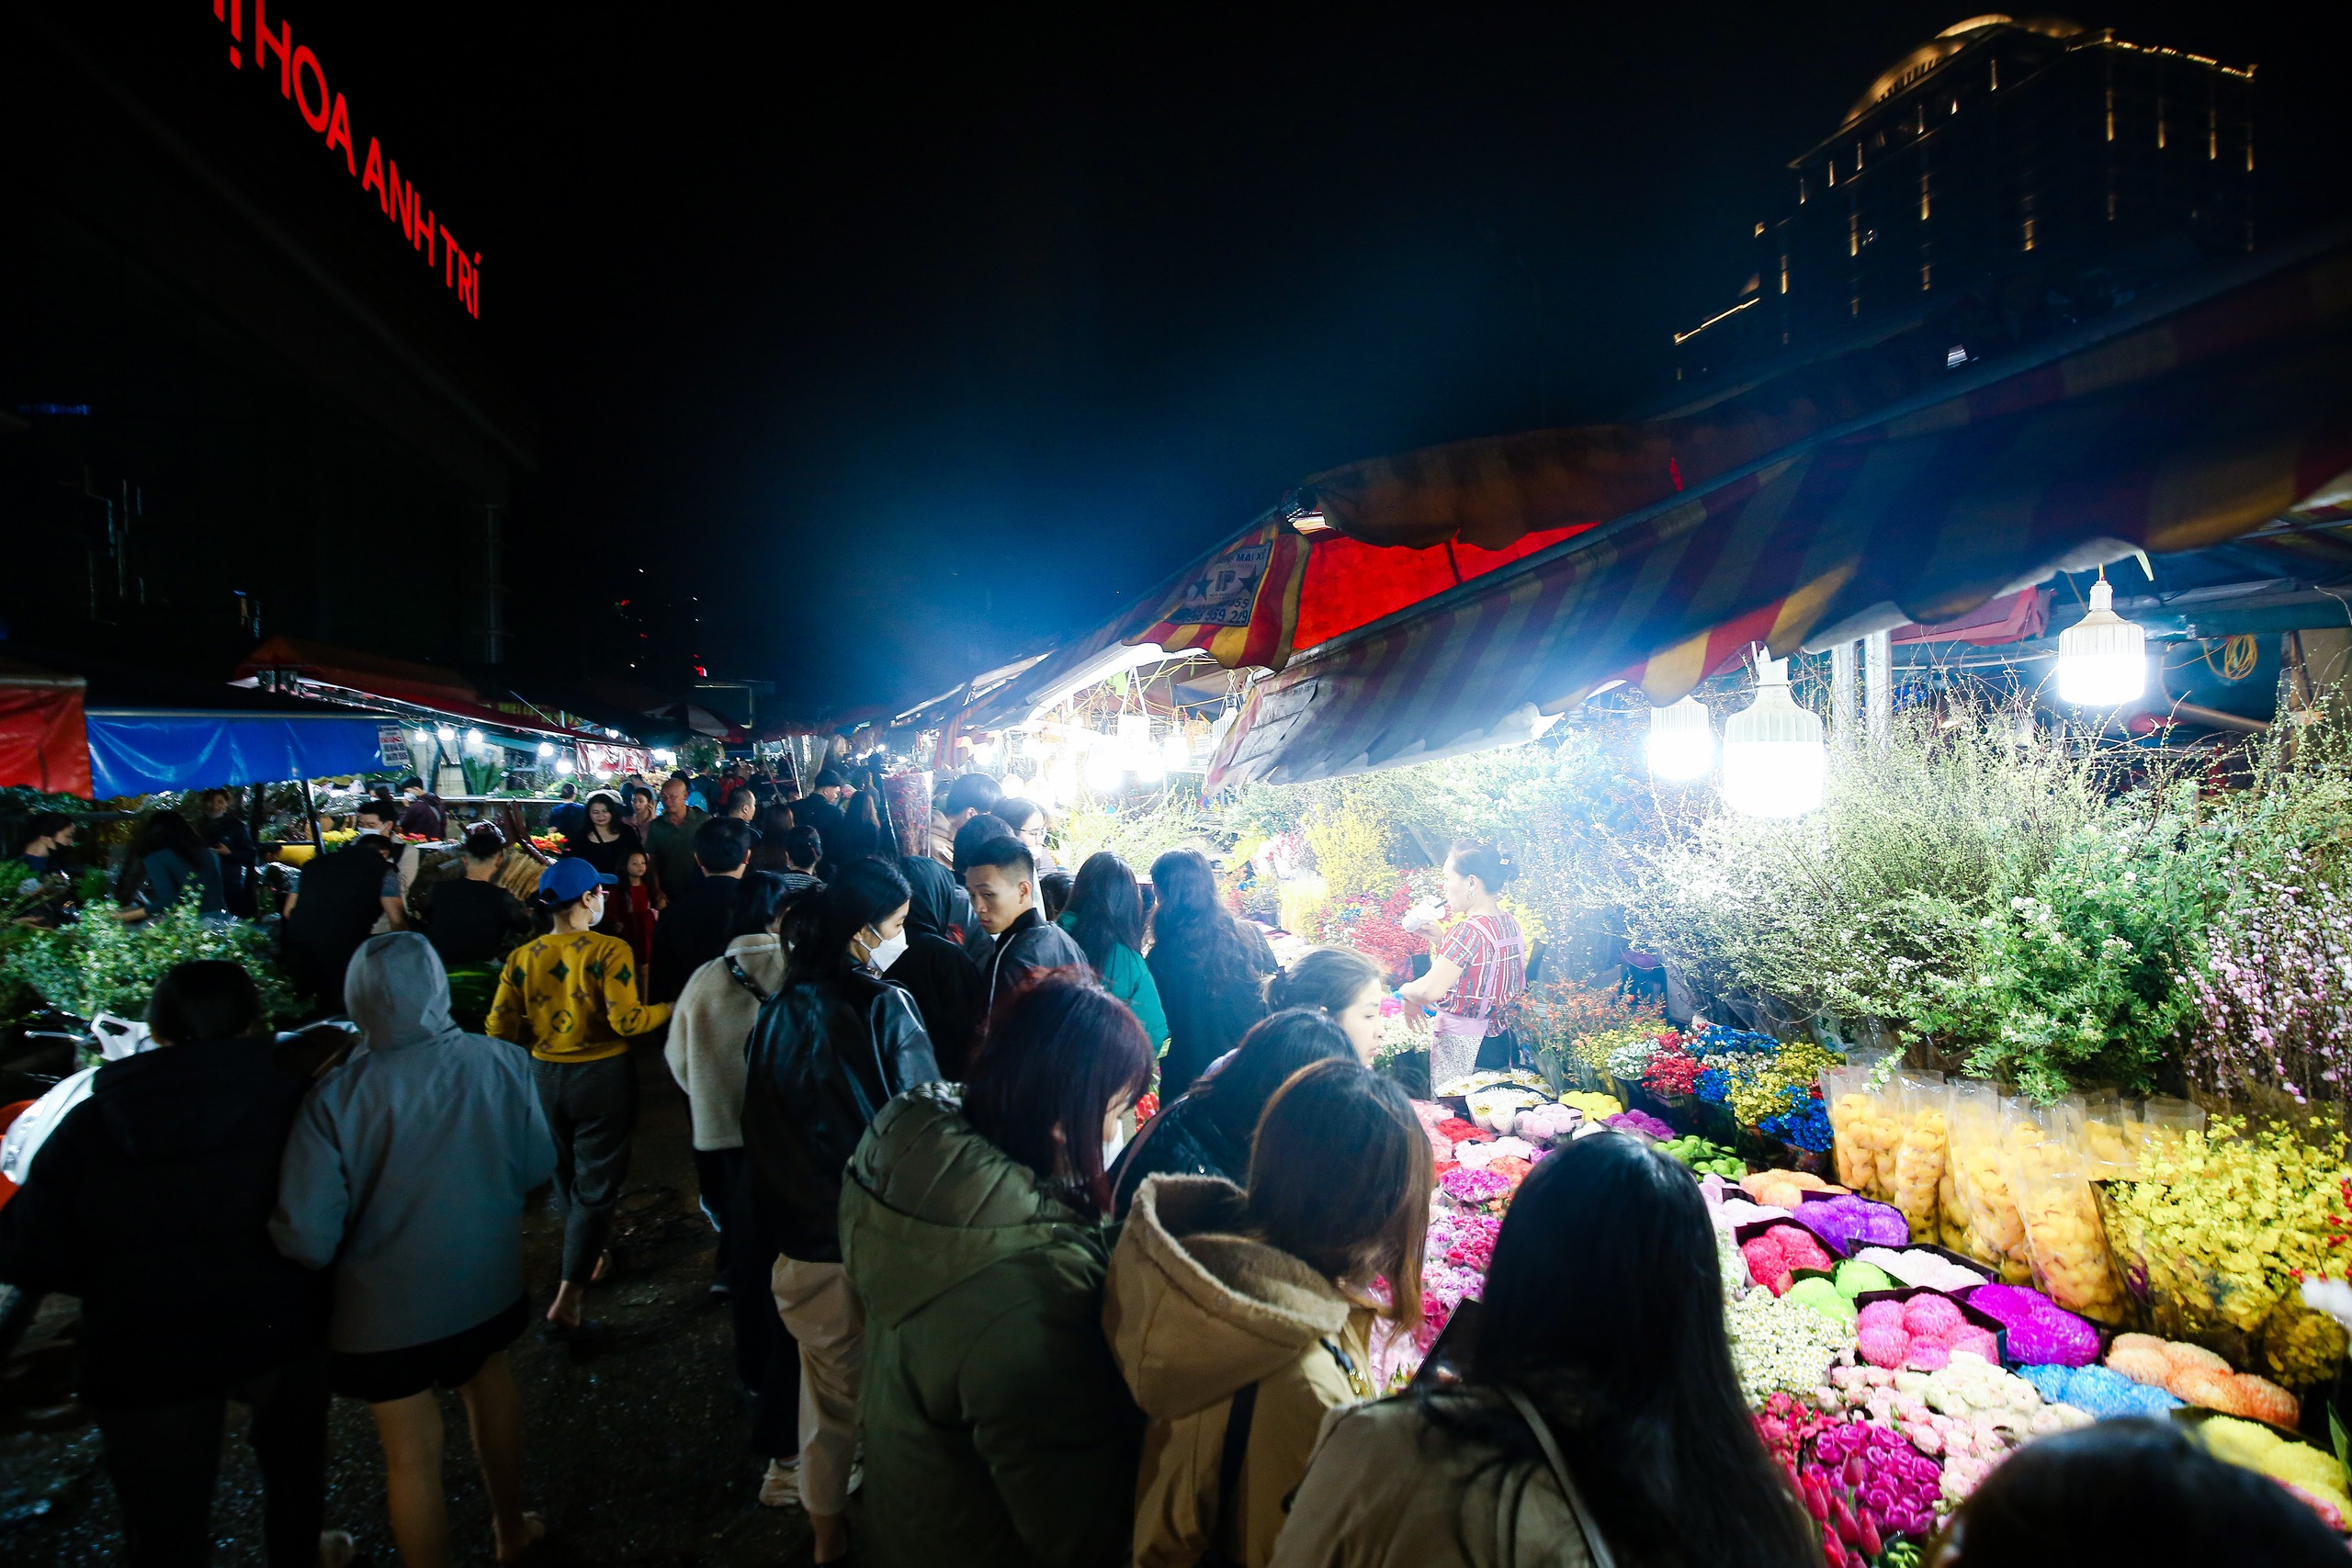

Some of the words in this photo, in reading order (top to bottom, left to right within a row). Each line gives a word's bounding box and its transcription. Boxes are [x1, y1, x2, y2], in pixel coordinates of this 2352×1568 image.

[255, 0, 356, 177] HOA
[362, 136, 435, 267] ANH
[439, 223, 481, 320] TRÍ
